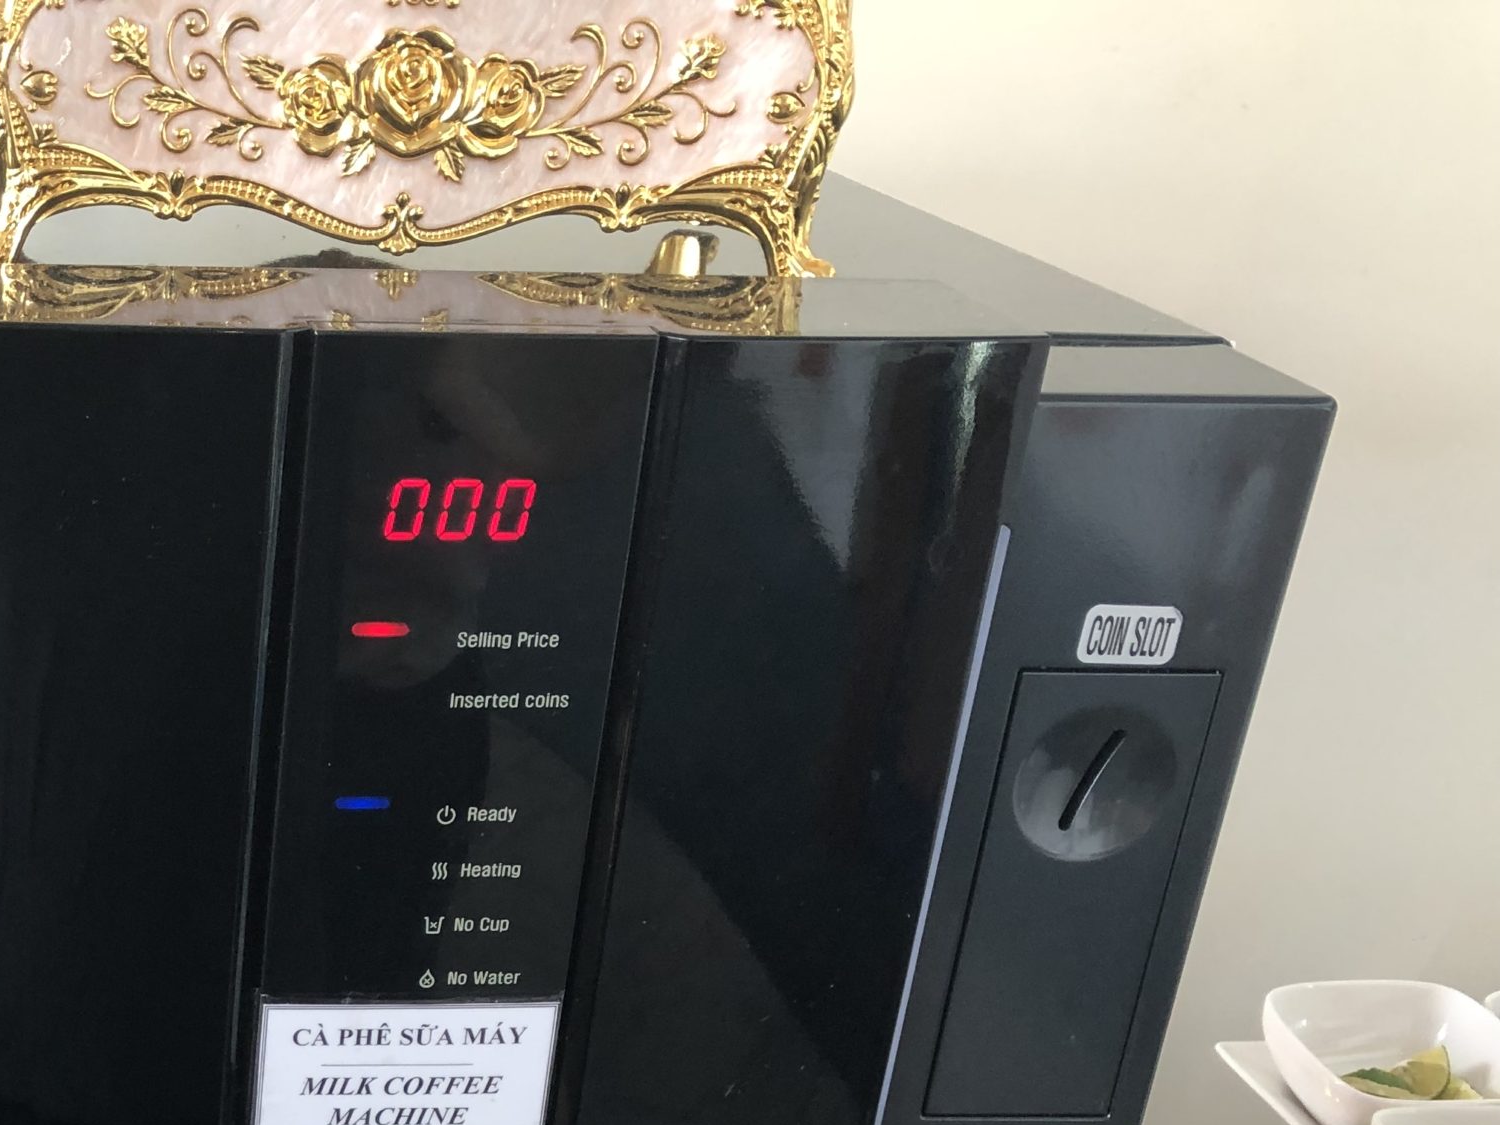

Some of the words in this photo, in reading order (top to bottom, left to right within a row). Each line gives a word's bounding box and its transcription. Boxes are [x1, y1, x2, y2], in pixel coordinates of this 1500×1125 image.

[383, 478, 537, 541] 000
[457, 631, 512, 650] Selling
[517, 632, 560, 648] Price
[1086, 615, 1131, 655] COIN
[1130, 616, 1176, 657] SLOT
[449, 692, 519, 709] Inserted
[525, 693, 570, 709] coins
[467, 806, 517, 823] Ready
[460, 862, 522, 879] Heating
[453, 917, 474, 932] No
[480, 917, 510, 933] Cup
[447, 971, 468, 986] No
[473, 971, 521, 986] Water
[292, 1023, 330, 1047] CÀ
[337, 1022, 392, 1047] PHÊ
[462, 1021, 528, 1046] MÁY
[299, 1076, 379, 1097] MILK
[384, 1075, 504, 1096] COFFEE
